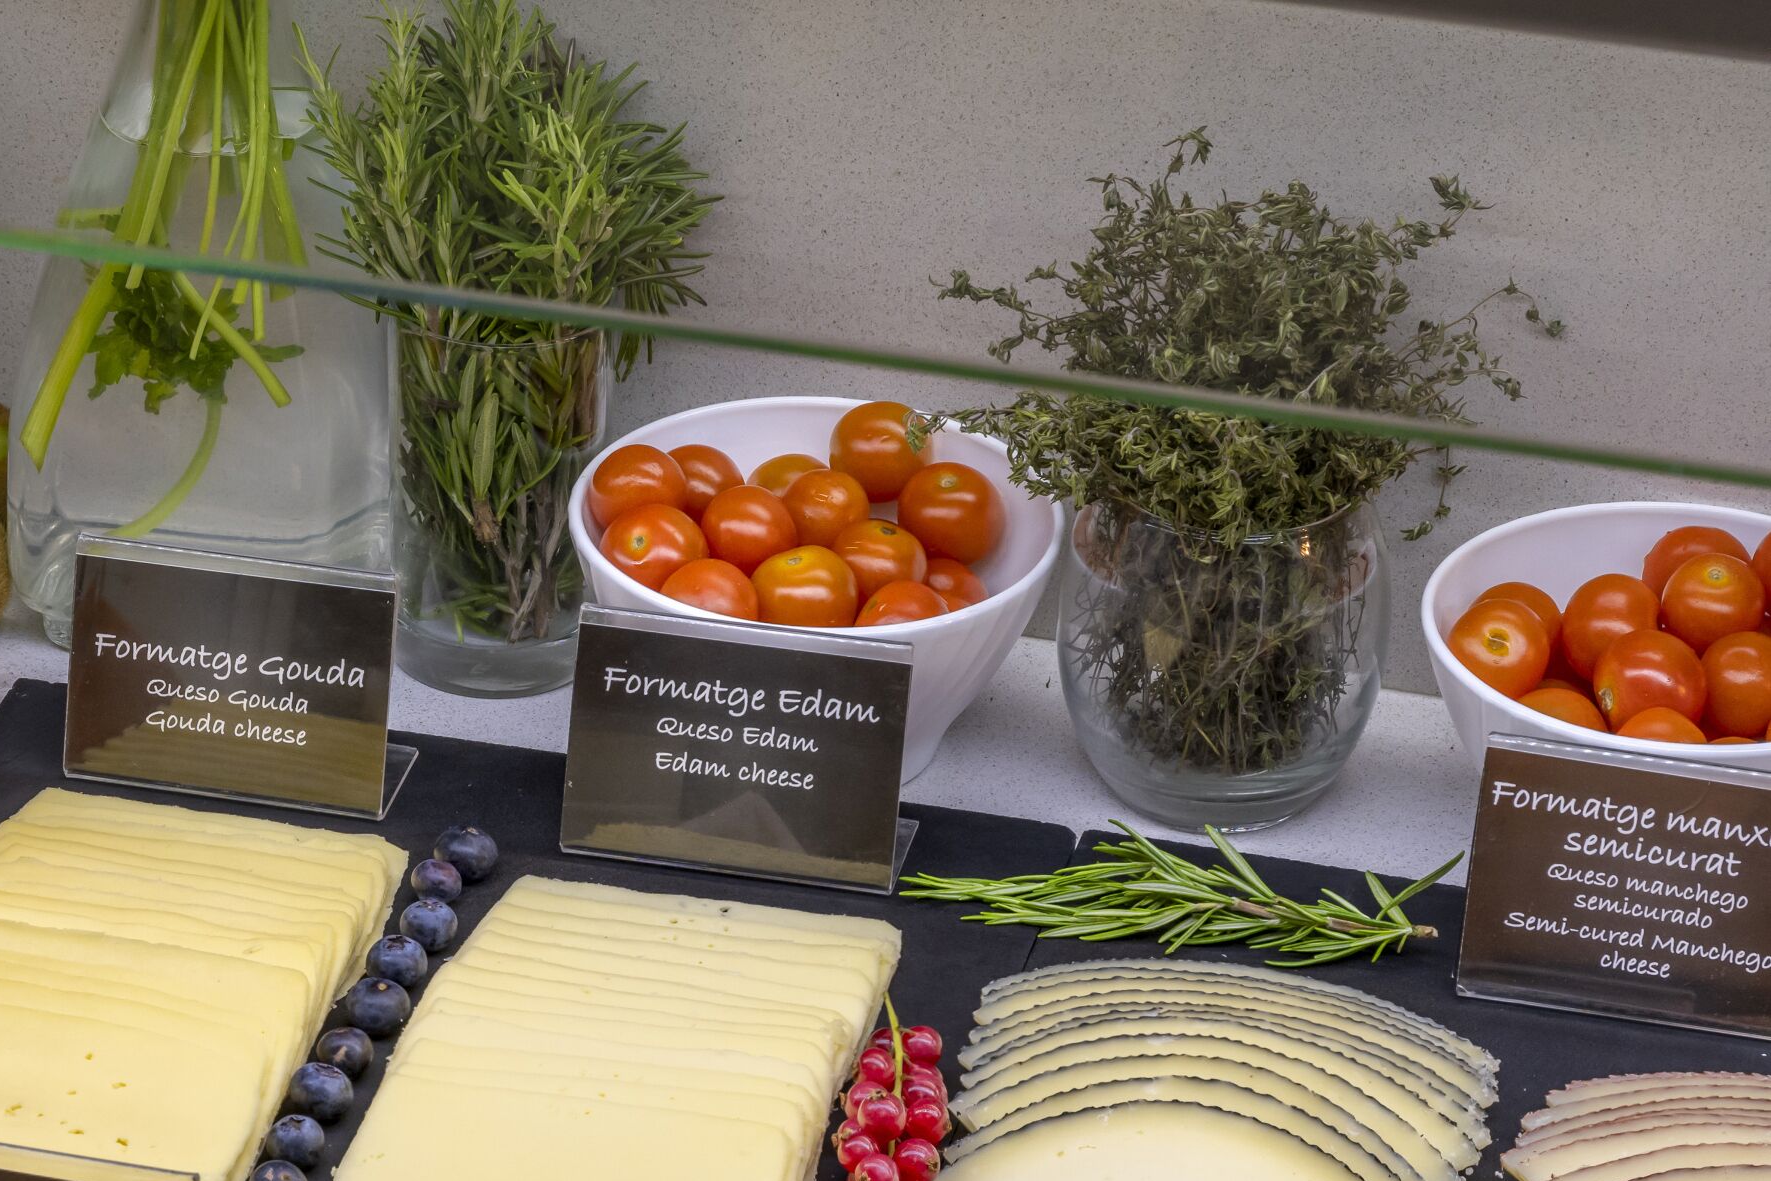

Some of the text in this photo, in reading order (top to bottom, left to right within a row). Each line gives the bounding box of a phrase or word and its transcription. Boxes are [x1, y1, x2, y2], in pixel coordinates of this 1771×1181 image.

[95, 633, 364, 687] Formatge Gouda
[146, 679, 308, 714] Queso Gouda
[604, 667, 879, 723] Formatge Edam
[146, 711, 306, 745] Gouda cheese
[657, 718, 818, 752] Queso Edam
[656, 752, 813, 789] Edam cheese
[1492, 781, 1771, 846] Formatge manx
[1563, 831, 1742, 877] semicurat
[1548, 864, 1748, 914] Queso manchego
[1574, 892, 1714, 930] semicurado
[1504, 912, 1771, 974] Semi-cured Manchego
[1601, 951, 1670, 978] cheese
